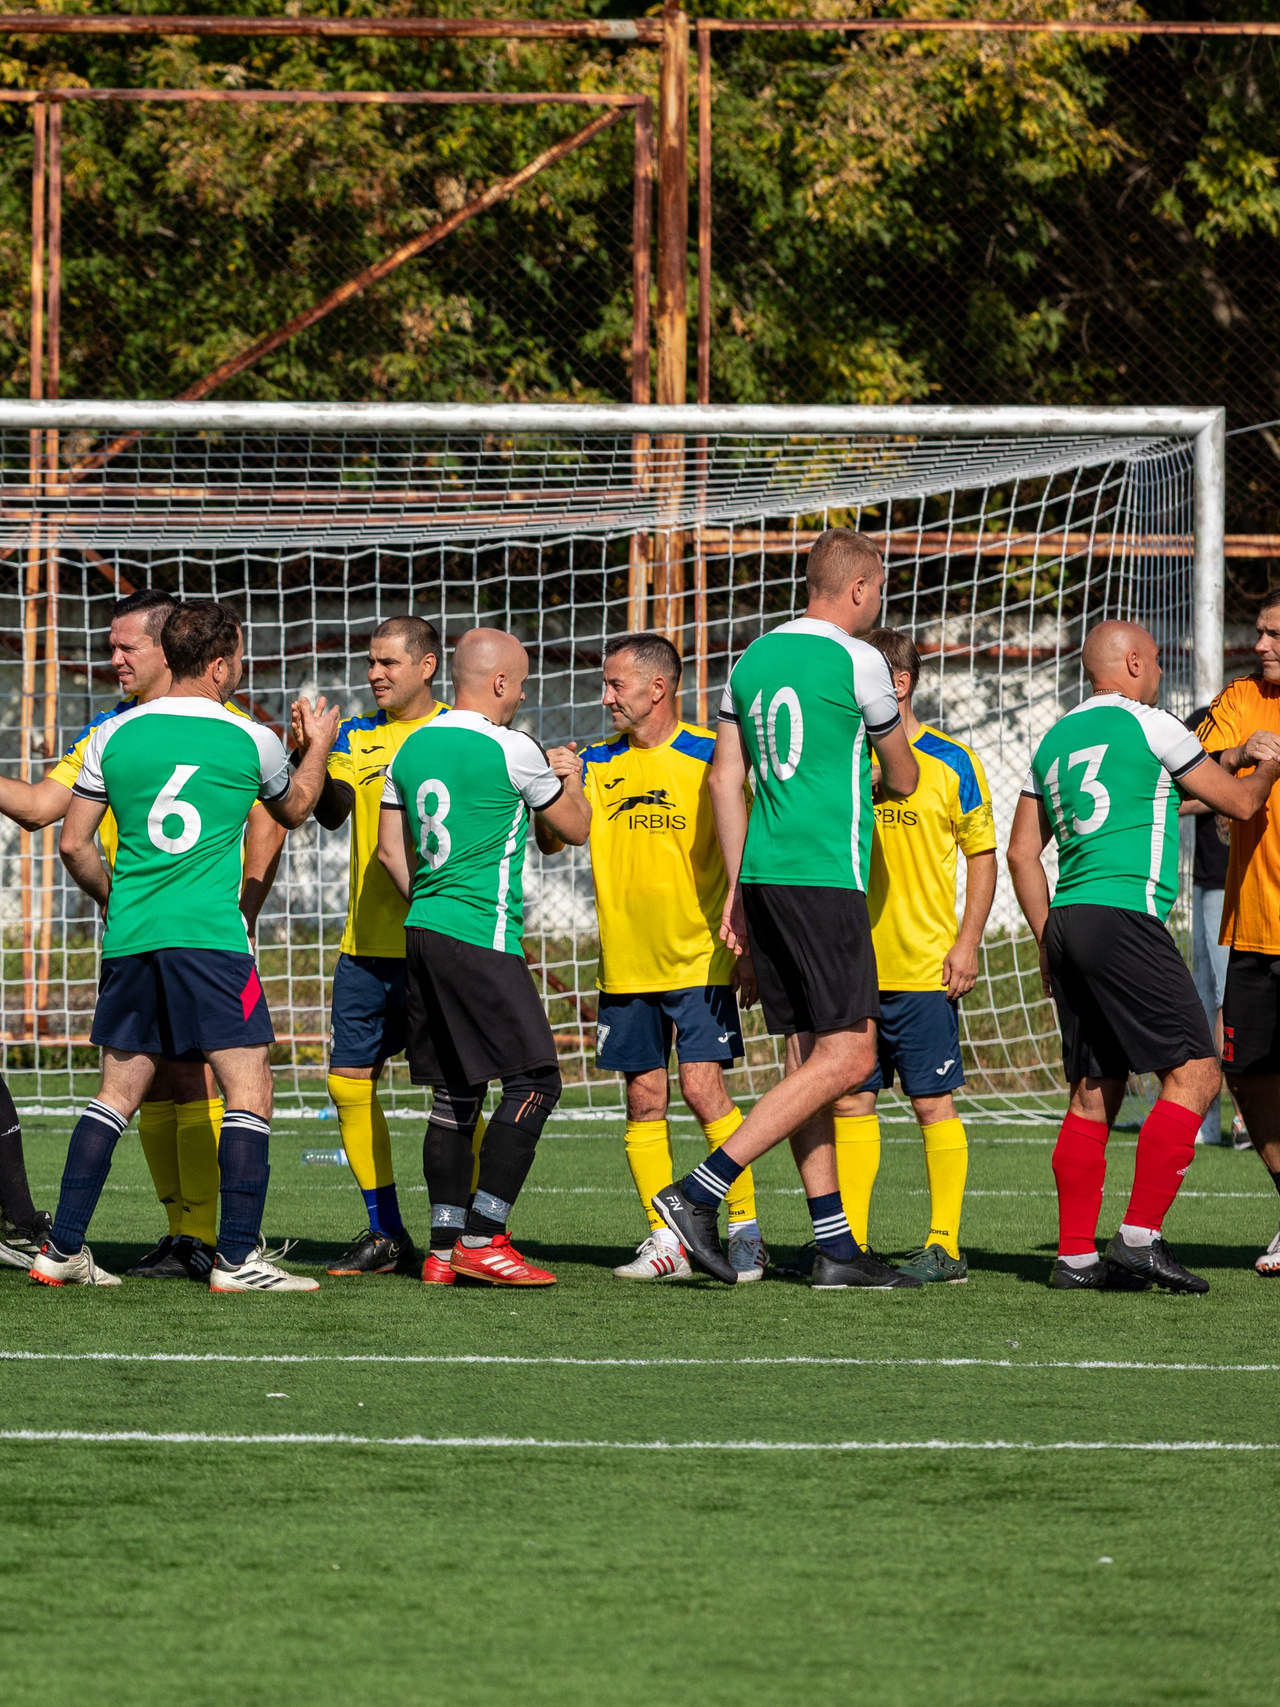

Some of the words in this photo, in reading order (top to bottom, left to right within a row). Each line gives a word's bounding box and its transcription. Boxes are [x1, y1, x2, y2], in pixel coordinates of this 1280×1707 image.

[747, 686, 804, 781] 10
[147, 764, 202, 854] 6
[416, 778, 451, 870] 8
[629, 814, 686, 830] IRBIS
[874, 808, 917, 826] RBIS
[1043, 744, 1110, 842] 13
